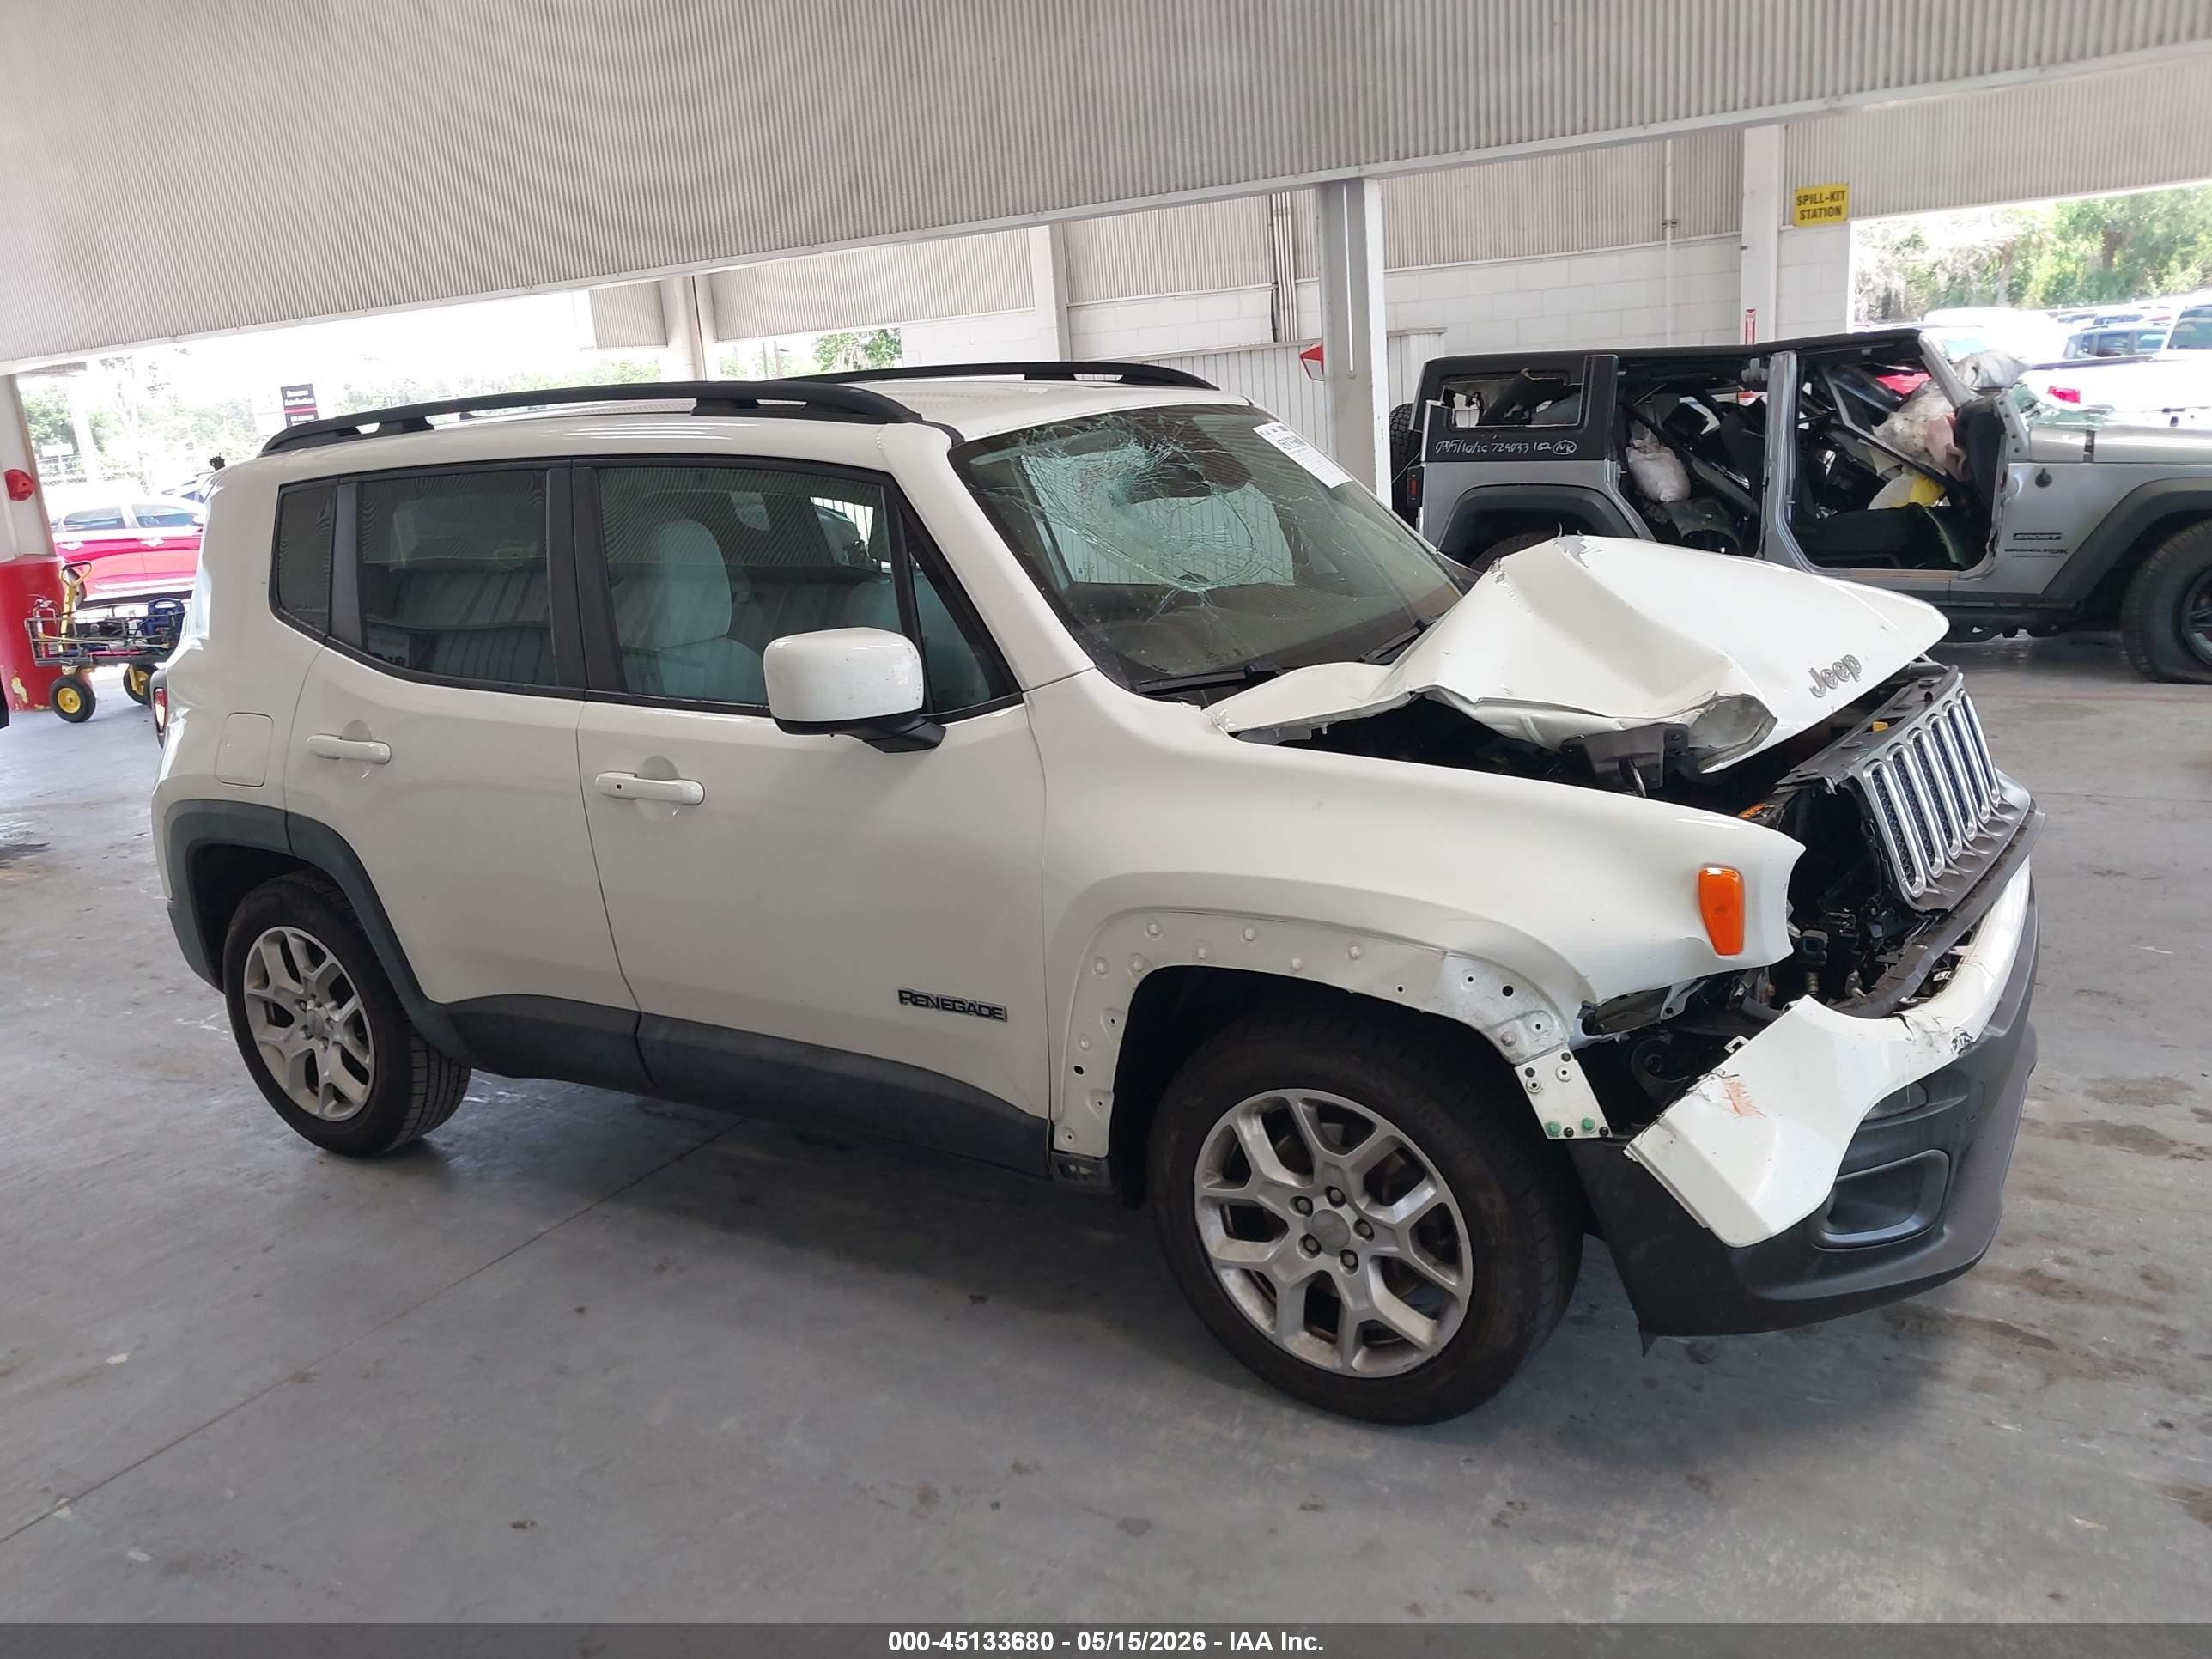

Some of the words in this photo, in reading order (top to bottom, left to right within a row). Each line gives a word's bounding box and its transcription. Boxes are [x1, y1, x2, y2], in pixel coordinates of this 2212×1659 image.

[1796, 190, 1846, 206] SPILL-KIT
[1800, 205, 1842, 220] STATION
[1808, 653, 1862, 698] Jeep
[897, 988, 1007, 1022] RENEGADE
